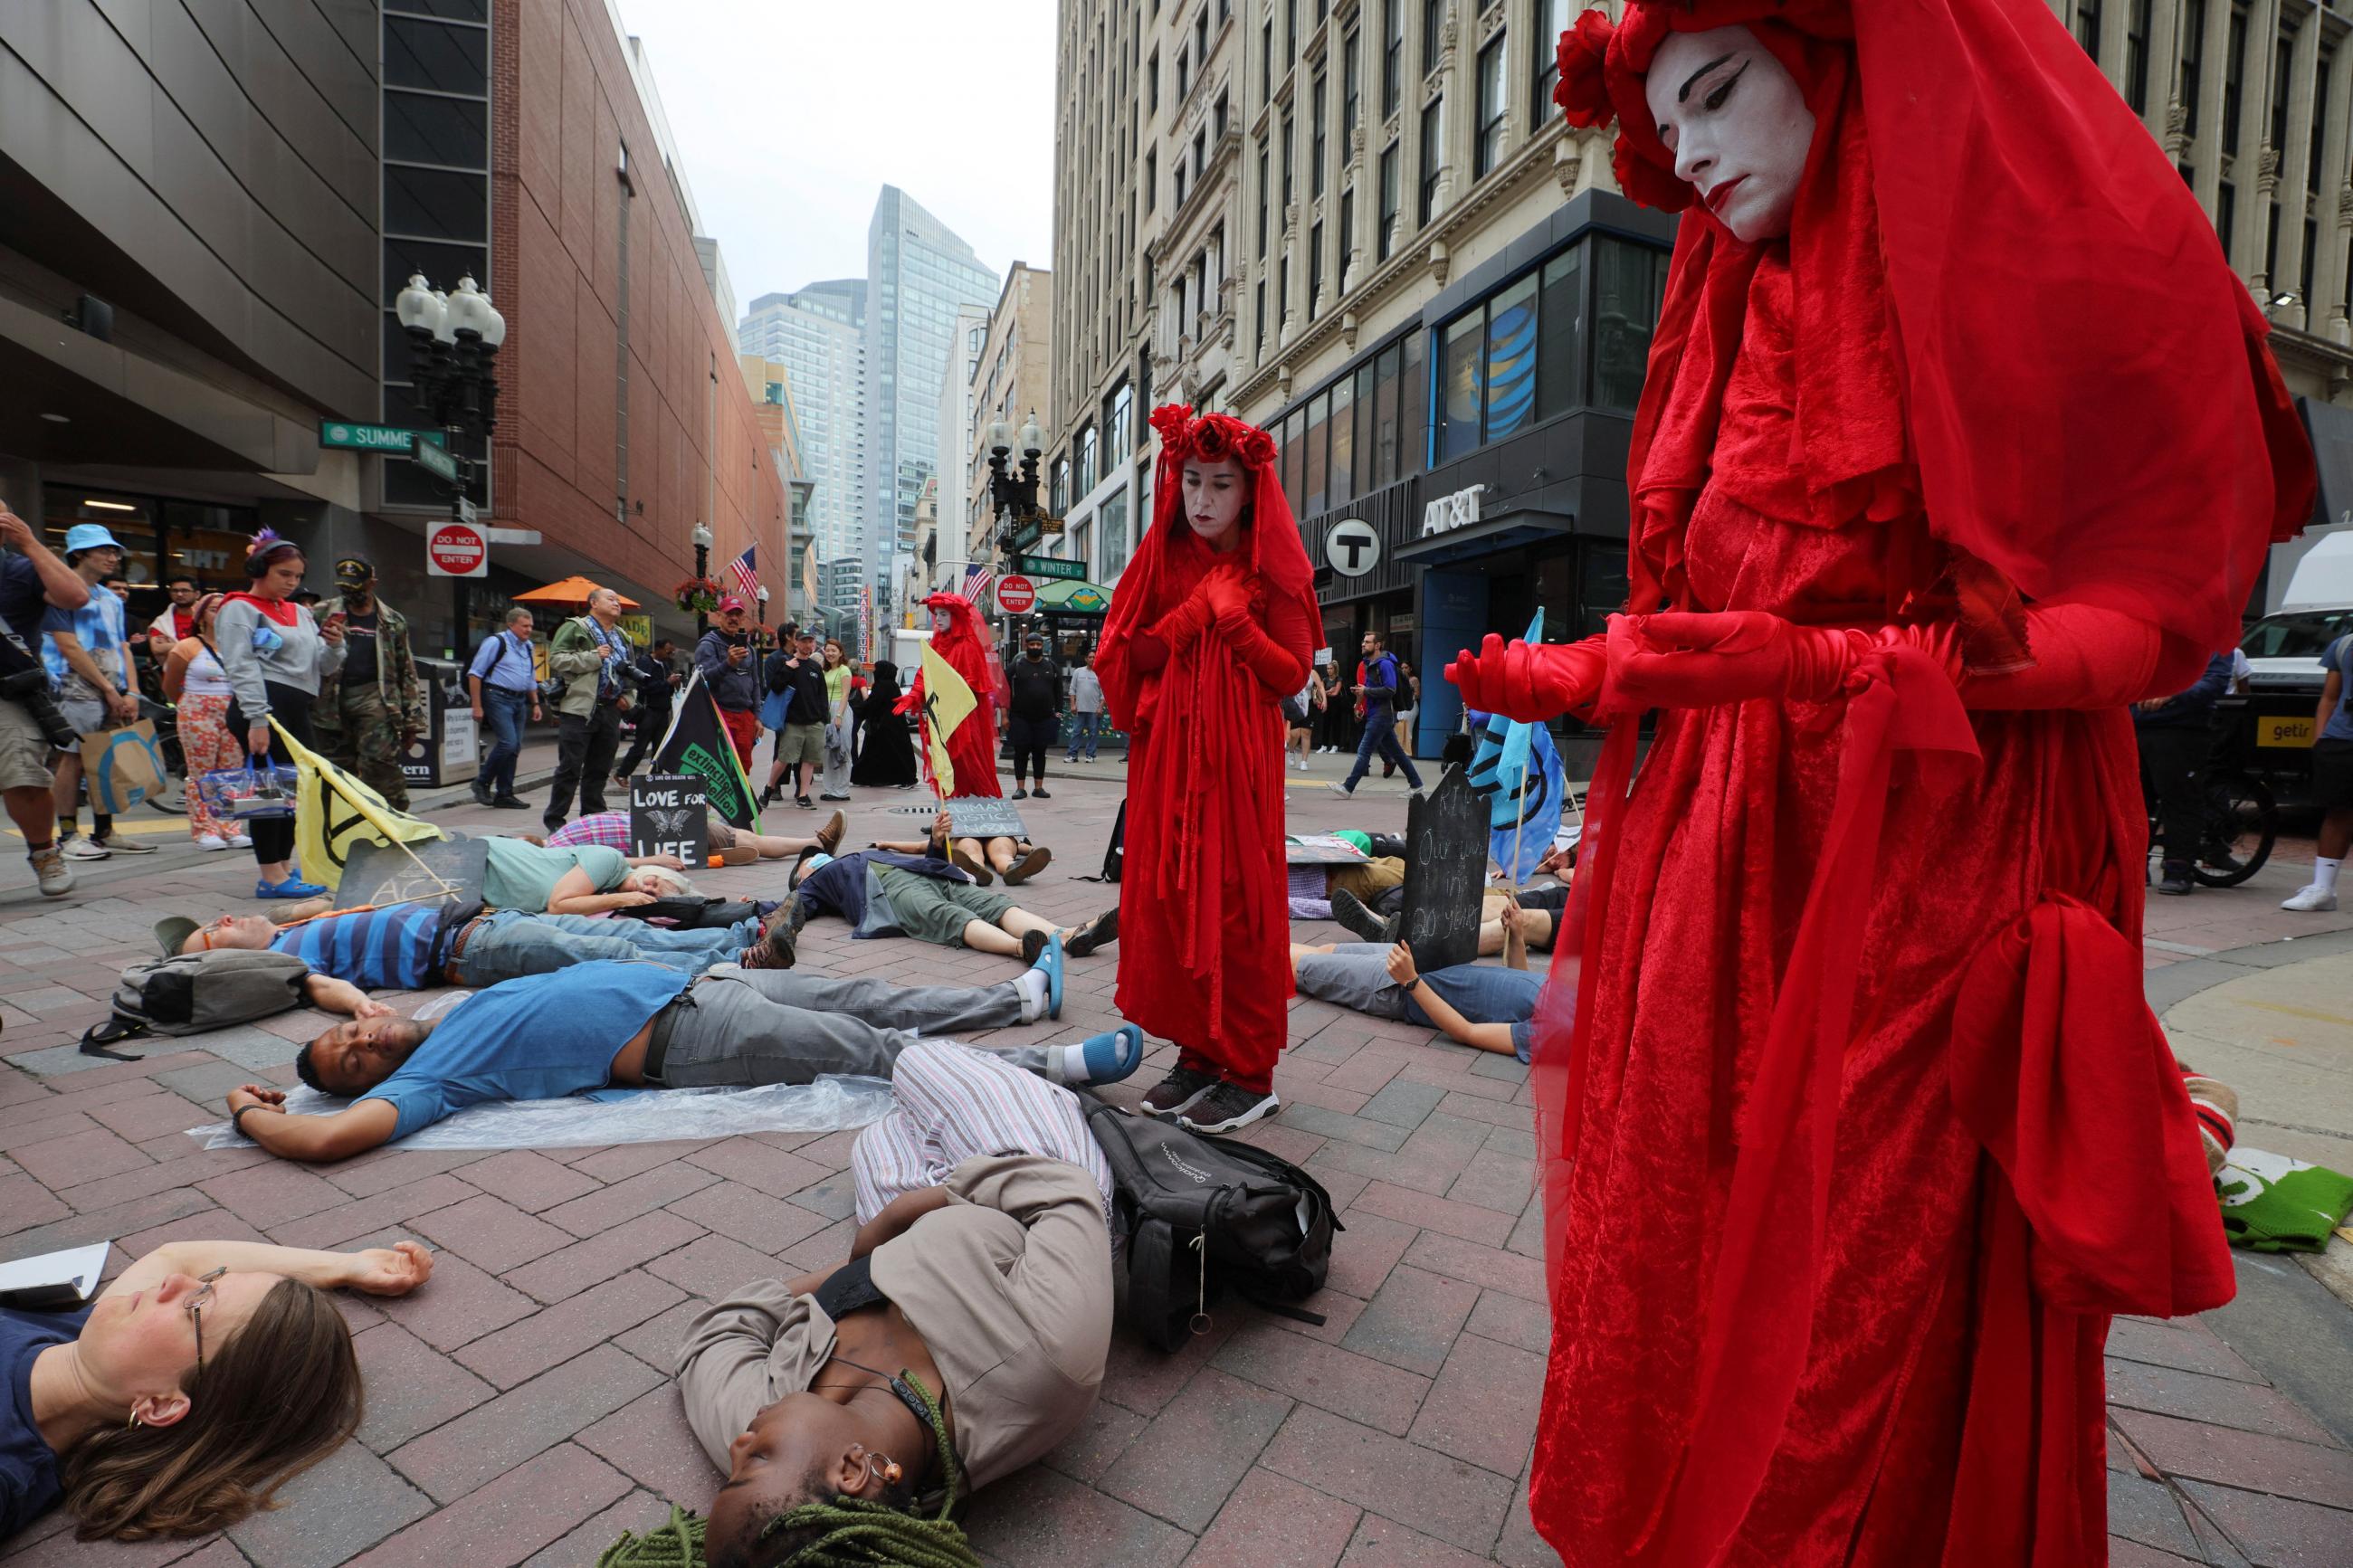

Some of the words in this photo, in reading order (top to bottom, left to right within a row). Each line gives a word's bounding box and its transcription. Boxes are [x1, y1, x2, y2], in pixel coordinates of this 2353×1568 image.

[356, 428, 413, 447] SUMME
[1423, 484, 1484, 537] AT&T
[436, 536, 452, 544] DO
[456, 537, 477, 545] NOT
[441, 556, 473, 564] ENTER
[1337, 535, 1371, 568] T
[1040, 561, 1072, 575] WINTER
[2273, 724, 2310, 741] getir
[398, 765, 430, 774] ern
[687, 749, 733, 797] extinction
[634, 789, 679, 807] LOVE
[684, 794, 705, 805] FOR
[1439, 785, 1472, 820] RIP
[1160, 1142, 1206, 1183] Qualcomm
